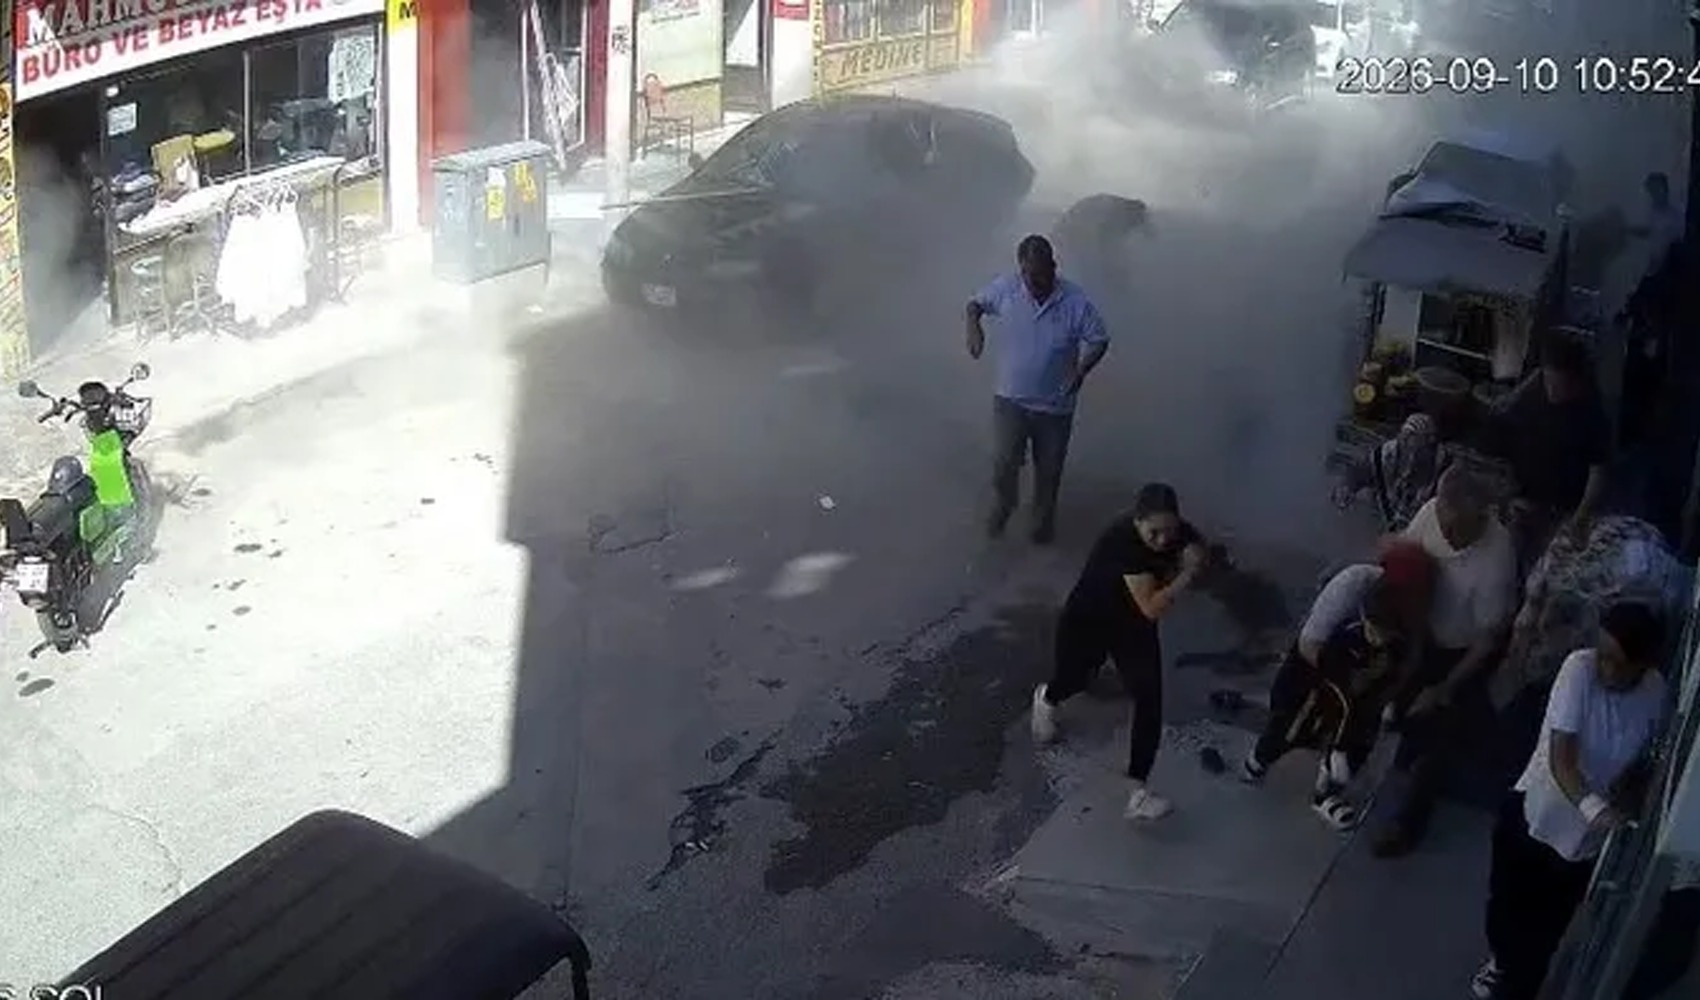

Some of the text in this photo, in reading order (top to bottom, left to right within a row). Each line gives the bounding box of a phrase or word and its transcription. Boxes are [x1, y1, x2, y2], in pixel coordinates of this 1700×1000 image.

[22, 40, 102, 85] BÜRO
[113, 25, 149, 55] VE
[158, 4, 246, 43] BEYAZ
